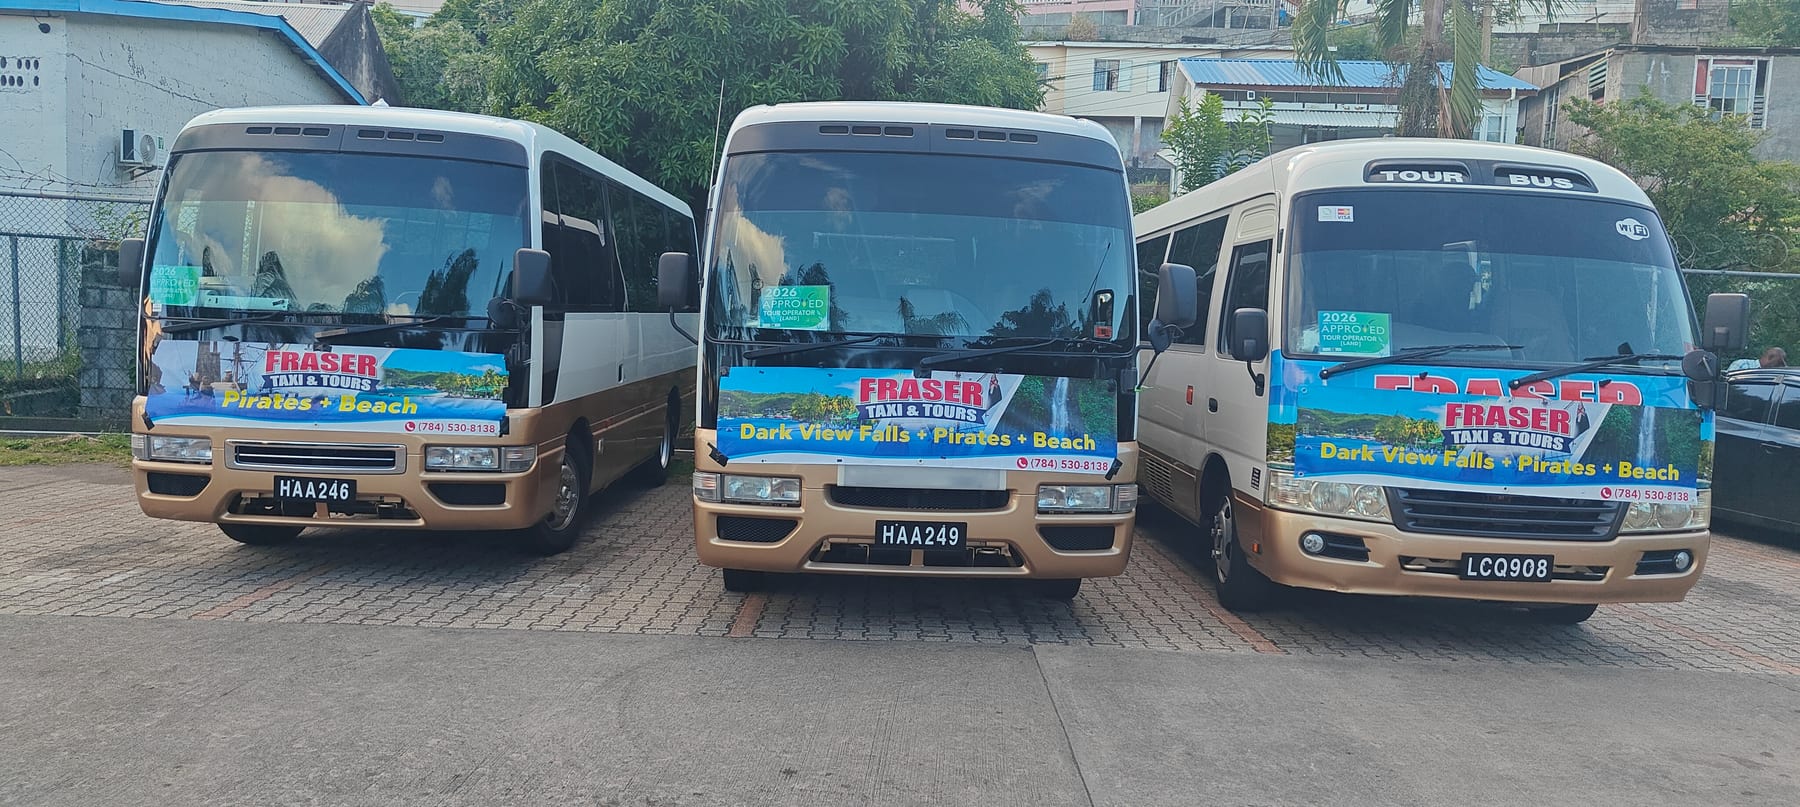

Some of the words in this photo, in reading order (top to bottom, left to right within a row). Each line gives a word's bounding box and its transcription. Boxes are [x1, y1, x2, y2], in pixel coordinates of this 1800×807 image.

[1380, 171, 1464, 183] TOUR
[1509, 174, 1573, 189] BUS
[153, 267, 176, 275] 2026
[765, 288, 797, 297] 2026
[1323, 313, 1356, 322] 2026
[266, 351, 377, 376] FRASER
[270, 375, 303, 387] TAXI
[306, 377, 317, 388] &
[320, 376, 371, 391] TOURS
[860, 378, 983, 407] FRASER
[222, 390, 311, 410] Pirates
[321, 398, 333, 408] +
[339, 394, 418, 415] Beach
[865, 404, 903, 418] TAXI
[907, 405, 919, 417] &
[923, 405, 977, 422] TOURS
[418, 421, 444, 433] (784)
[447, 423, 495, 433] 530-8138
[1445, 403, 1570, 434] FRASER
[741, 424, 791, 440] Dark
[799, 425, 850, 442] View
[860, 425, 908, 443] Falls
[917, 429, 927, 440] +
[934, 427, 1011, 447] Pirates
[1017, 434, 1027, 444] +
[1033, 432, 1095, 450] Beach
[1451, 430, 1488, 446] TAXI
[1492, 432, 1506, 445] &
[1509, 431, 1564, 451] TOURS
[1030, 459, 1058, 470] (784)
[1061, 459, 1109, 471] 530-8138
[1320, 442, 1374, 462] Dark
[1382, 446, 1438, 466] View
[1444, 450, 1494, 470] Falls
[1502, 456, 1511, 467] +
[1519, 455, 1595, 477] Pirates
[1603, 464, 1613, 474] +
[1619, 462, 1679, 481] Beach
[279, 479, 349, 500] HAA246
[1614, 488, 1641, 500] (784)
[1645, 489, 1688, 502] 530-8138
[882, 525, 959, 546] HAA249
[1467, 556, 1548, 579] LCQ908
